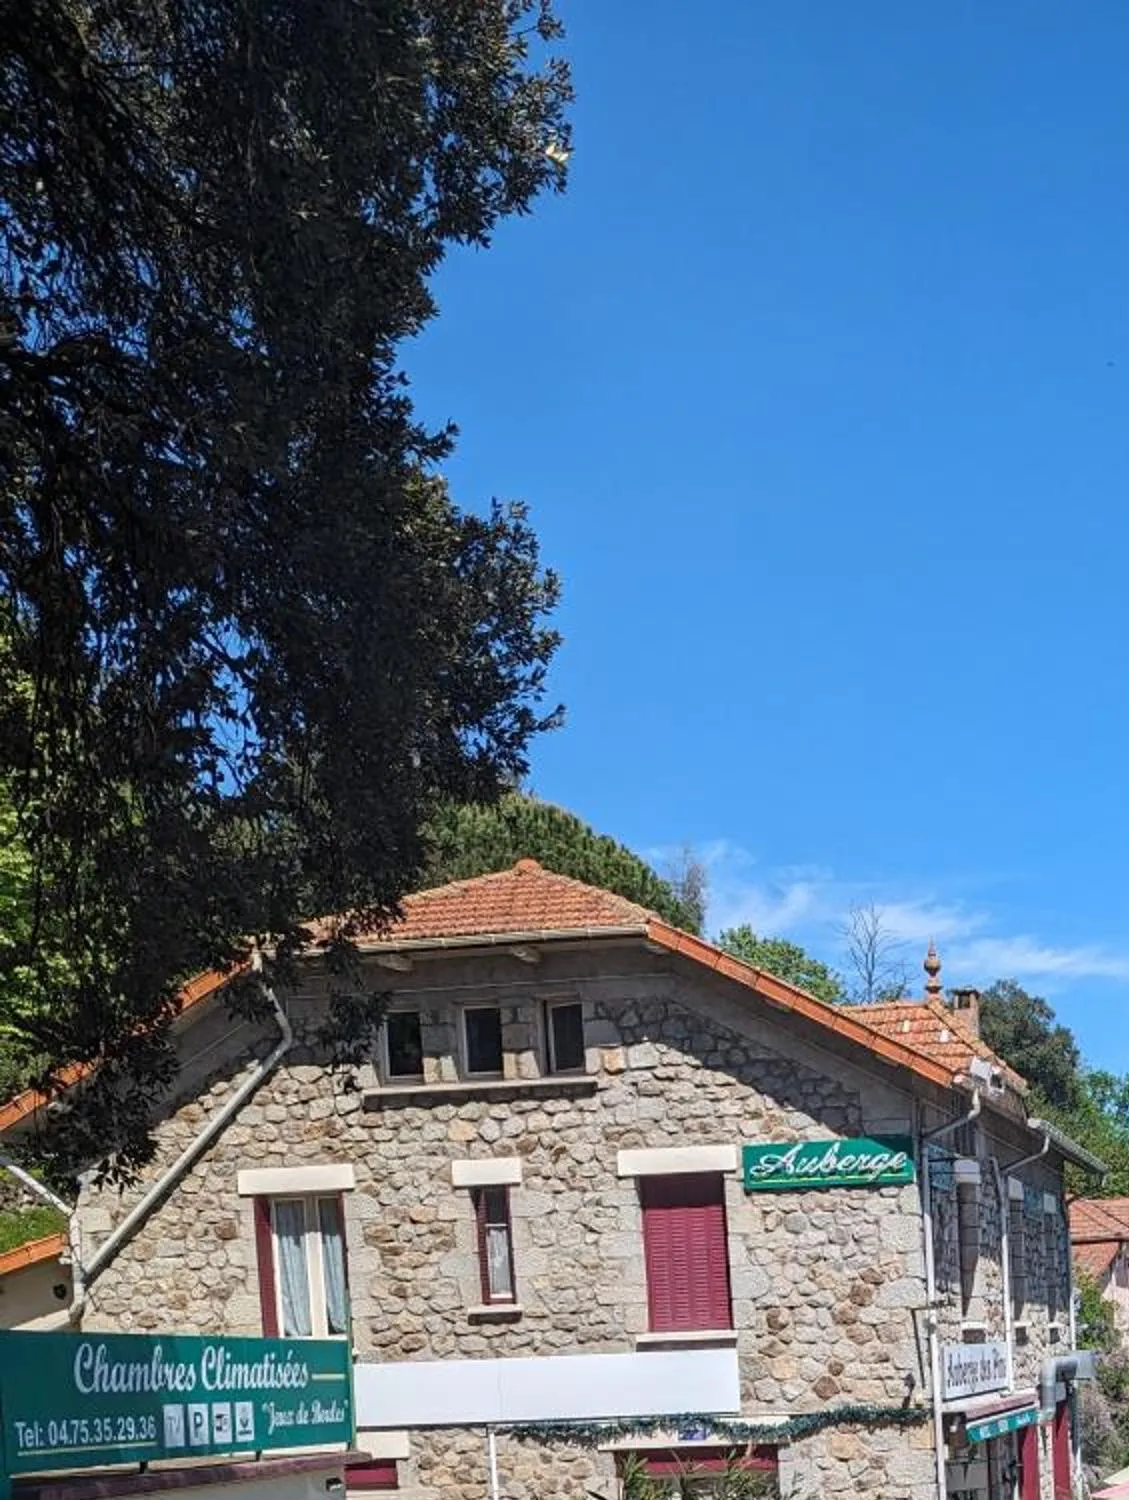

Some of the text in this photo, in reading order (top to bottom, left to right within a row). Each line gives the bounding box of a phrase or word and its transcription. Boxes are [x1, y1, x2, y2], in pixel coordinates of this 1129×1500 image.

[750, 1142, 907, 1181] Auberge
[73, 1343, 309, 1394] Chambres Climatisées
[15, 1415, 157, 1448] Tel: 04.75.35.29.36
